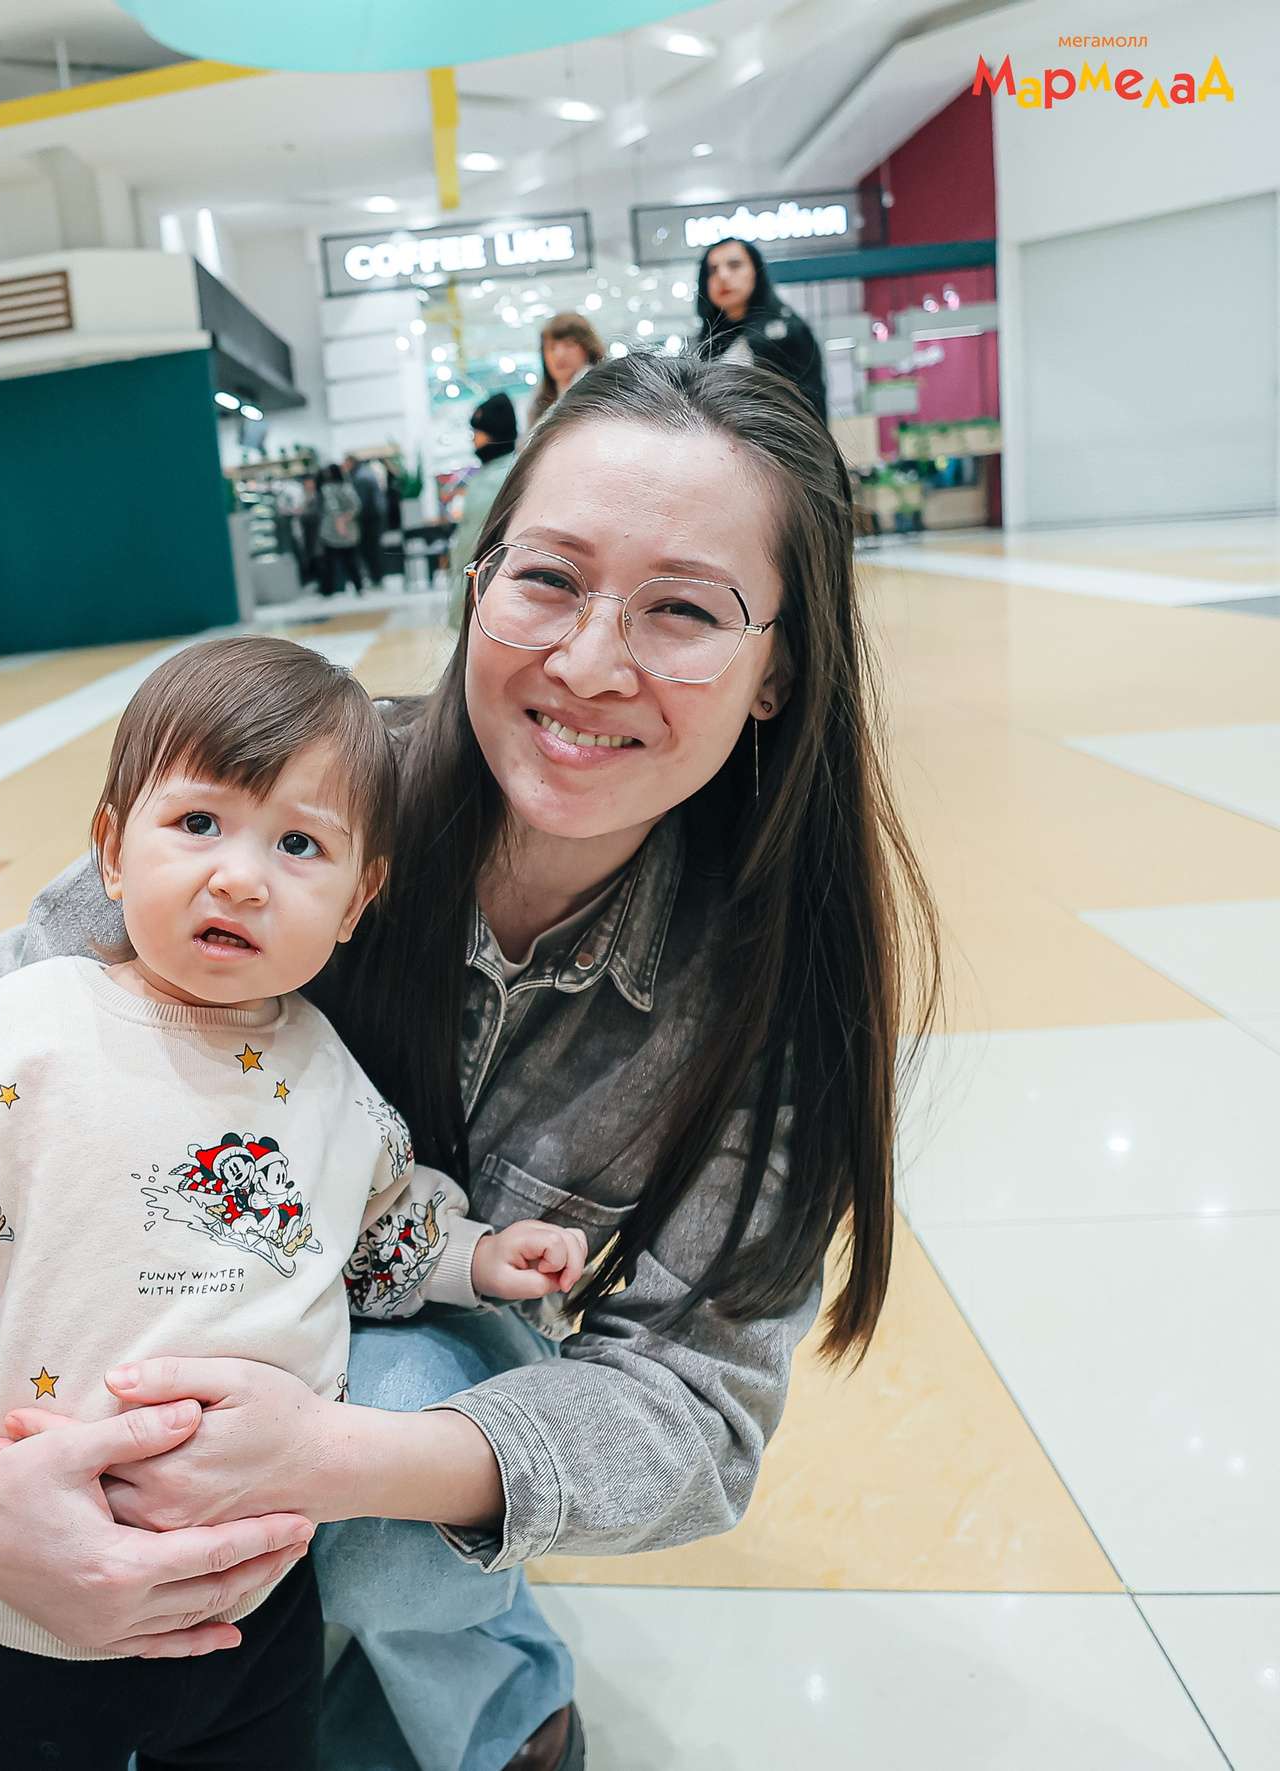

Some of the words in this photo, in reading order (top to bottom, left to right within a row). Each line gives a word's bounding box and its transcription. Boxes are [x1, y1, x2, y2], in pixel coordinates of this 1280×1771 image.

[344, 234, 487, 281] COFFEE
[494, 225, 575, 266] LIKE
[139, 1270, 187, 1281] FUNNY
[191, 1267, 245, 1280] WINTER
[138, 1285, 174, 1296] WITH
